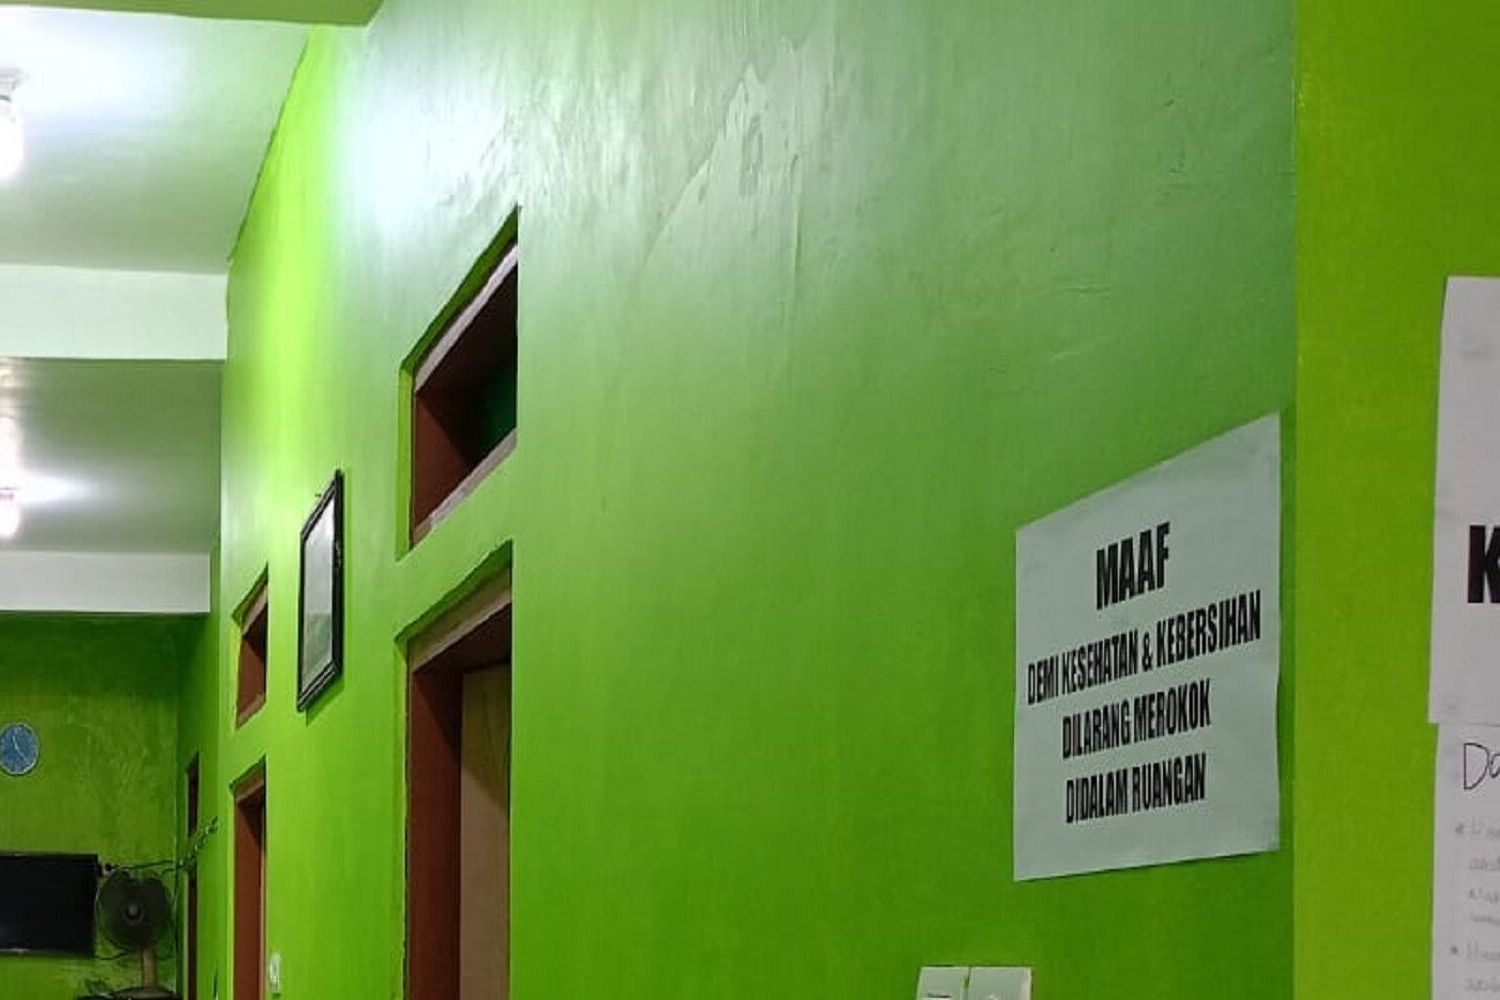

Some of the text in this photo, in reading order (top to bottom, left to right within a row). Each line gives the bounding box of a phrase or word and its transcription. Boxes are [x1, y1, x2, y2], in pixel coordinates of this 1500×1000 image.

[1096, 521, 1171, 611] MAAF
[1027, 589, 1261, 706] DEMI KESEHATAN & KEBERSIHAN
[1062, 678, 1211, 760] DILARANG MEROKOK
[1066, 752, 1207, 824] DIDALAM RUANGAN
